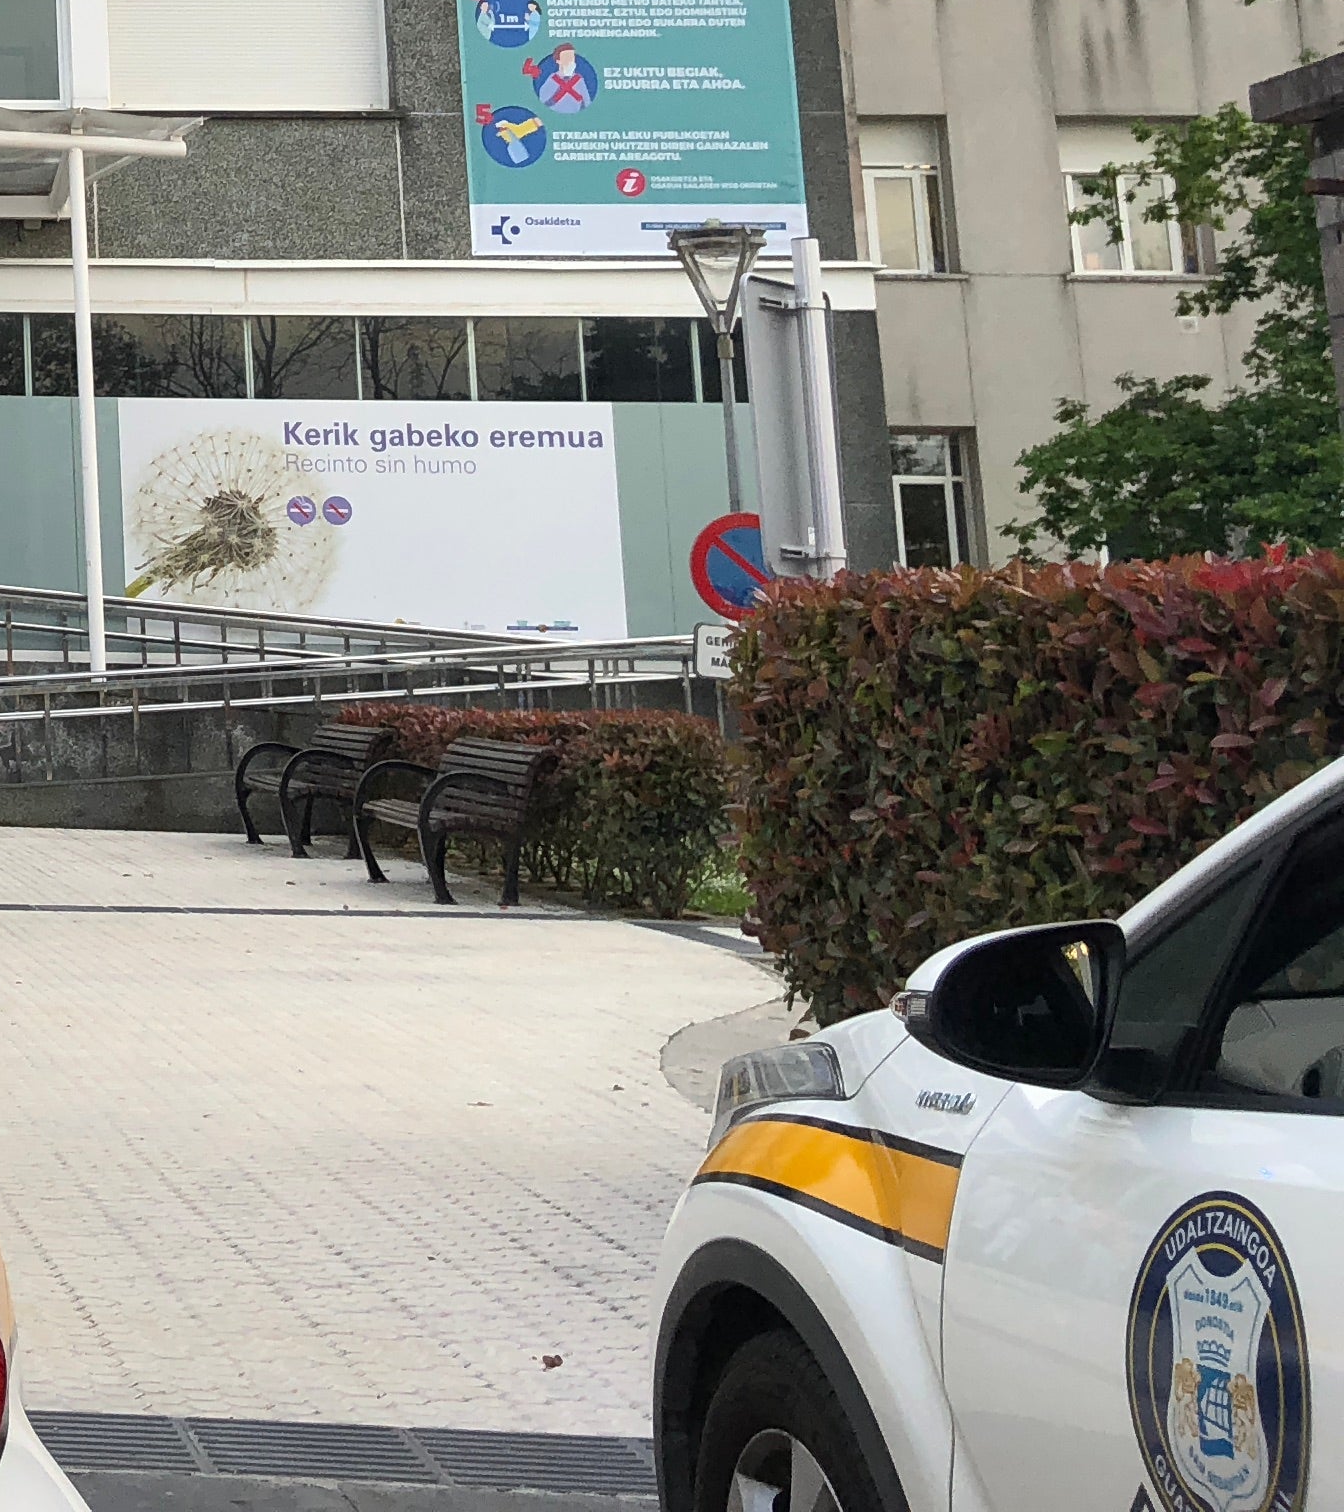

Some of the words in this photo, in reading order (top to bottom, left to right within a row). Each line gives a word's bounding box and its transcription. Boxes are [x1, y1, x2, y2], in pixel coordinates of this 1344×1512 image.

[522, 58, 540, 79] 4
[604, 67, 621, 77] EZ
[623, 67, 665, 77] UKITU
[672, 79, 699, 89] ETA
[476, 104, 493, 126] 5
[525, 216, 581, 226] Osakidetza
[283, 422, 359, 446] Kerik
[369, 423, 479, 452] gabeko
[489, 429, 604, 448] eremua
[285, 453, 367, 473] Recinto
[375, 454, 405, 473] sin
[414, 455, 477, 475] humo
[1164, 1212, 1276, 1288] UDALTZAINGOA
